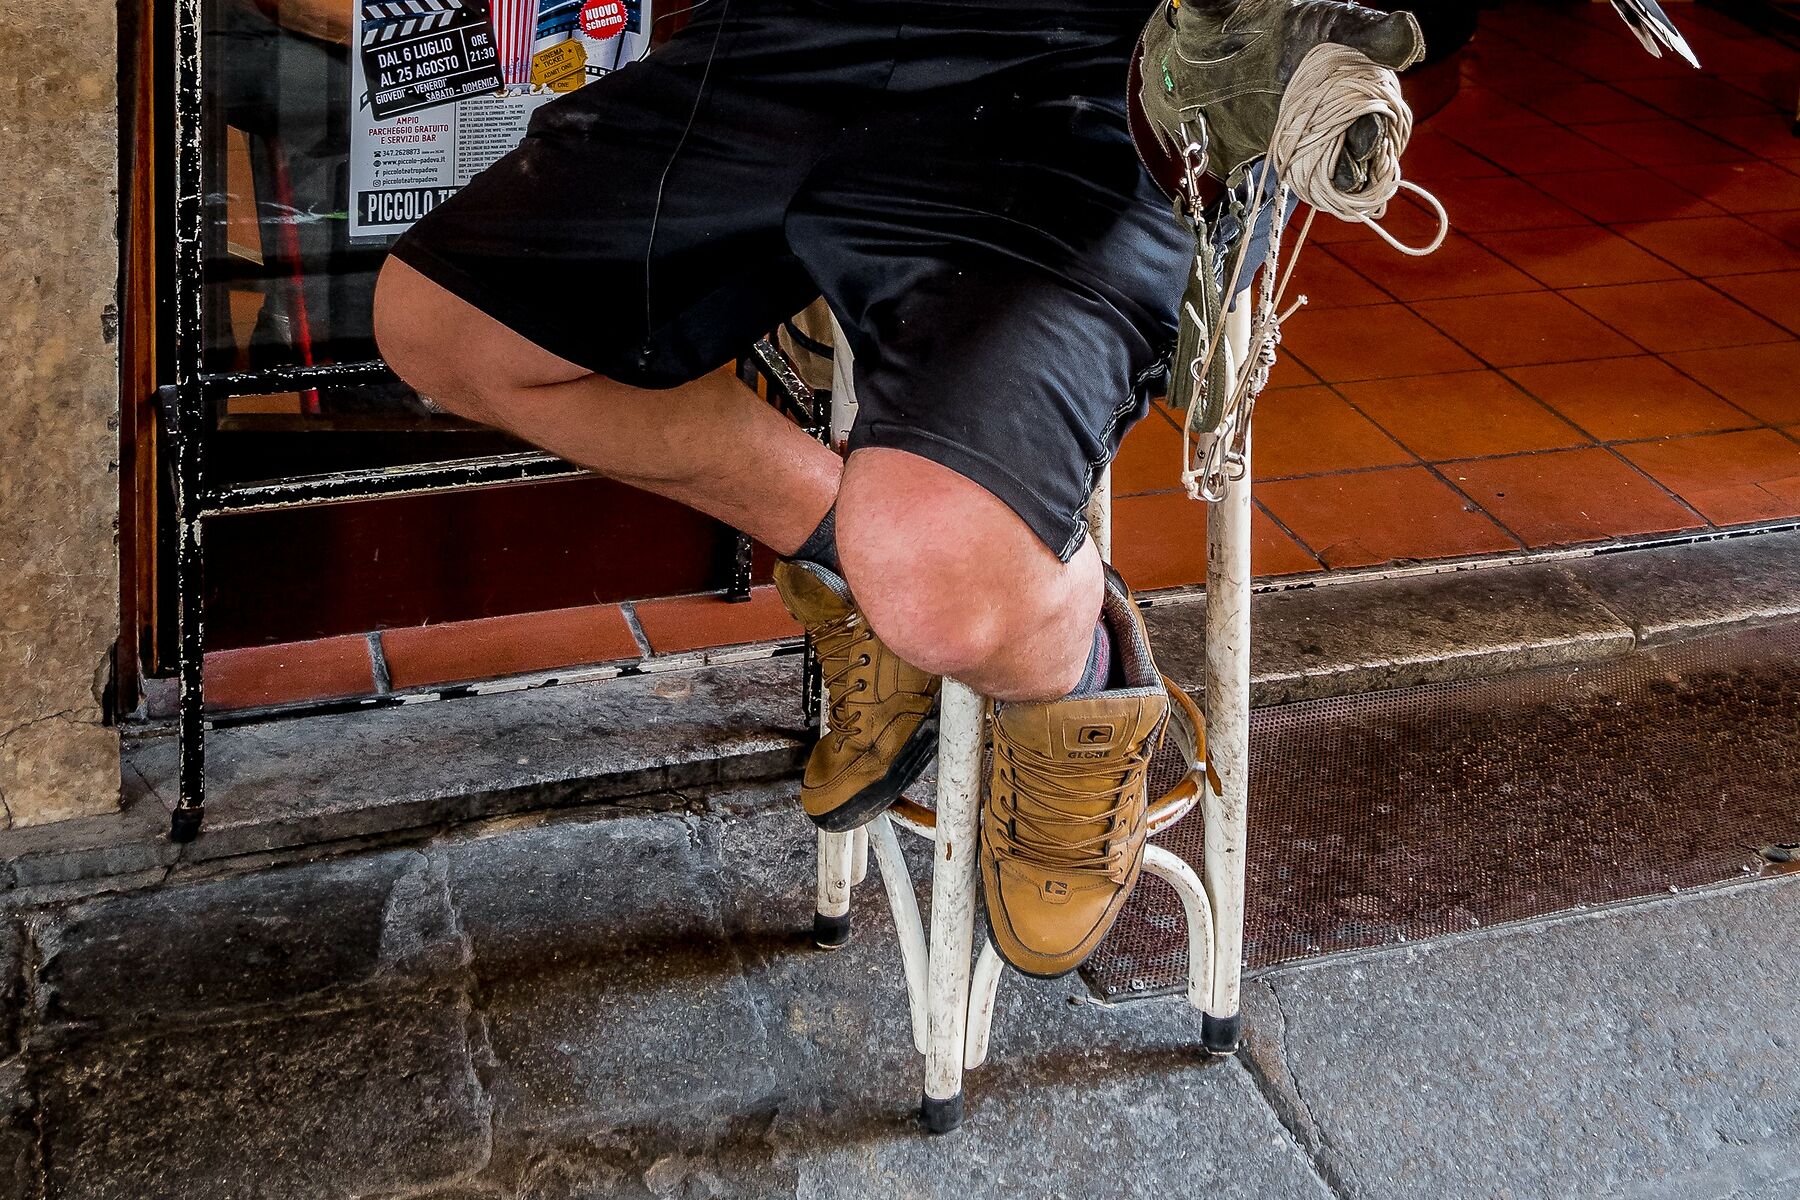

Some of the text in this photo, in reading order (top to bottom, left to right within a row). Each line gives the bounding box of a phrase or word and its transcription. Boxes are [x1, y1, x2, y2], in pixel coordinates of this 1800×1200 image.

[585, 2, 618, 21] NUOVO
[586, 15, 622, 31] schermo
[470, 33, 488, 47] ORE
[378, 37, 453, 68] DAL 6 LUGLIO
[470, 46, 495, 62] 21:30
[540, 48, 565, 62] CINEMA
[544, 54, 566, 68] TICKET
[380, 55, 460, 88] AL 25 AGOSTO
[544, 62, 574, 79] ADMIT ONE
[426, 88, 455, 102] SABATO
[462, 76, 500, 93] DOMENICA
[396, 116, 419, 125] AMPIO
[368, 124, 449, 136] PARCHEGGIO GRATUITO
[381, 134, 437, 144] E SERVIZIO BAR
[382, 148, 420, 157] 347.2628873
[382, 167, 438, 176] piccoloteatropadova
[382, 177, 438, 186] piccoloteatropadova
[368, 190, 433, 222] PICCOLO
[1068, 750, 1111, 760] GLOBE
